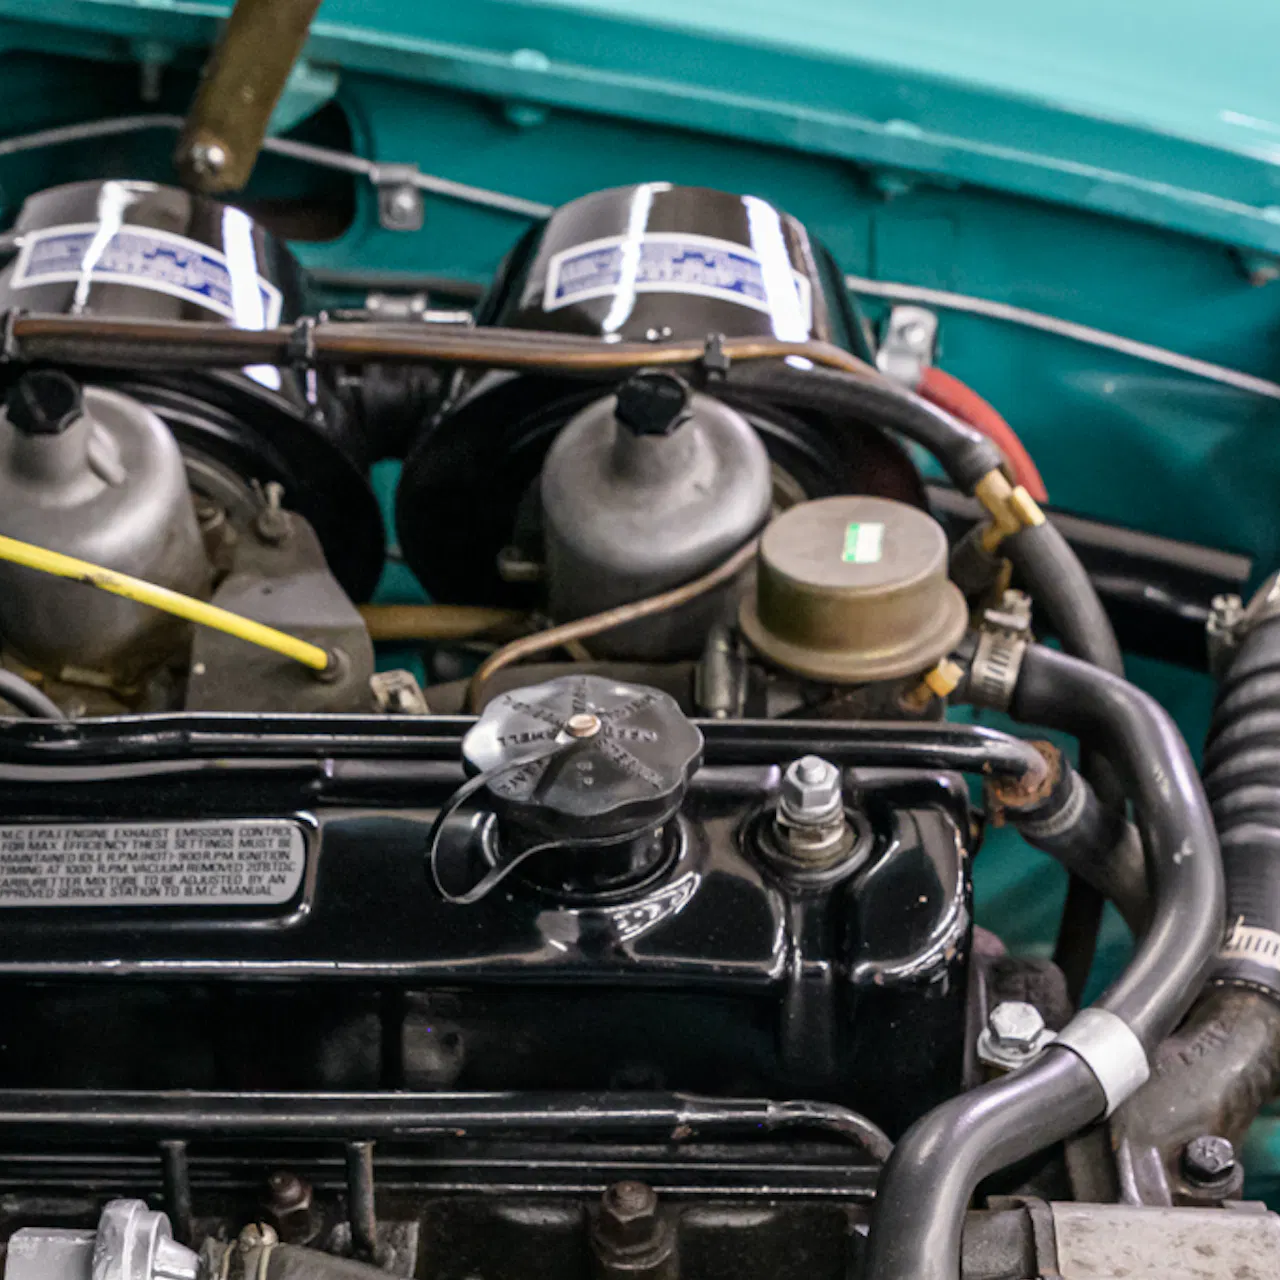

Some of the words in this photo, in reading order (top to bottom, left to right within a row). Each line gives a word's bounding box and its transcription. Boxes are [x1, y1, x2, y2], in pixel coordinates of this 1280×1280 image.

[114, 829, 170, 839] EXHAUST
[175, 828, 234, 838] EMISSION
[238, 827, 292, 837] CONTROL
[1, 841, 25, 850] FOR
[132, 839, 168, 848] THESE
[175, 839, 234, 848] SETTINGS
[238, 838, 274, 847] MUST
[0, 853, 77, 863] MAINTAINED
[0, 865, 43, 875] TIMING
[47, 864, 61, 874] AT
[132, 863, 184, 873] VACUUM
[186, 863, 244, 873] REMOVED
[86, 876, 137, 886] MIXTURE
[144, 875, 158, 885] TO
[161, 875, 174, 885] BE
[180, 875, 243, 885] ADJUSTED
[248, 874, 263, 884] BY
[268, 874, 286, 884] AN
[57, 887, 105, 897] SERVICE
[110, 887, 161, 897] STATION
[164, 886, 180, 896] TO
